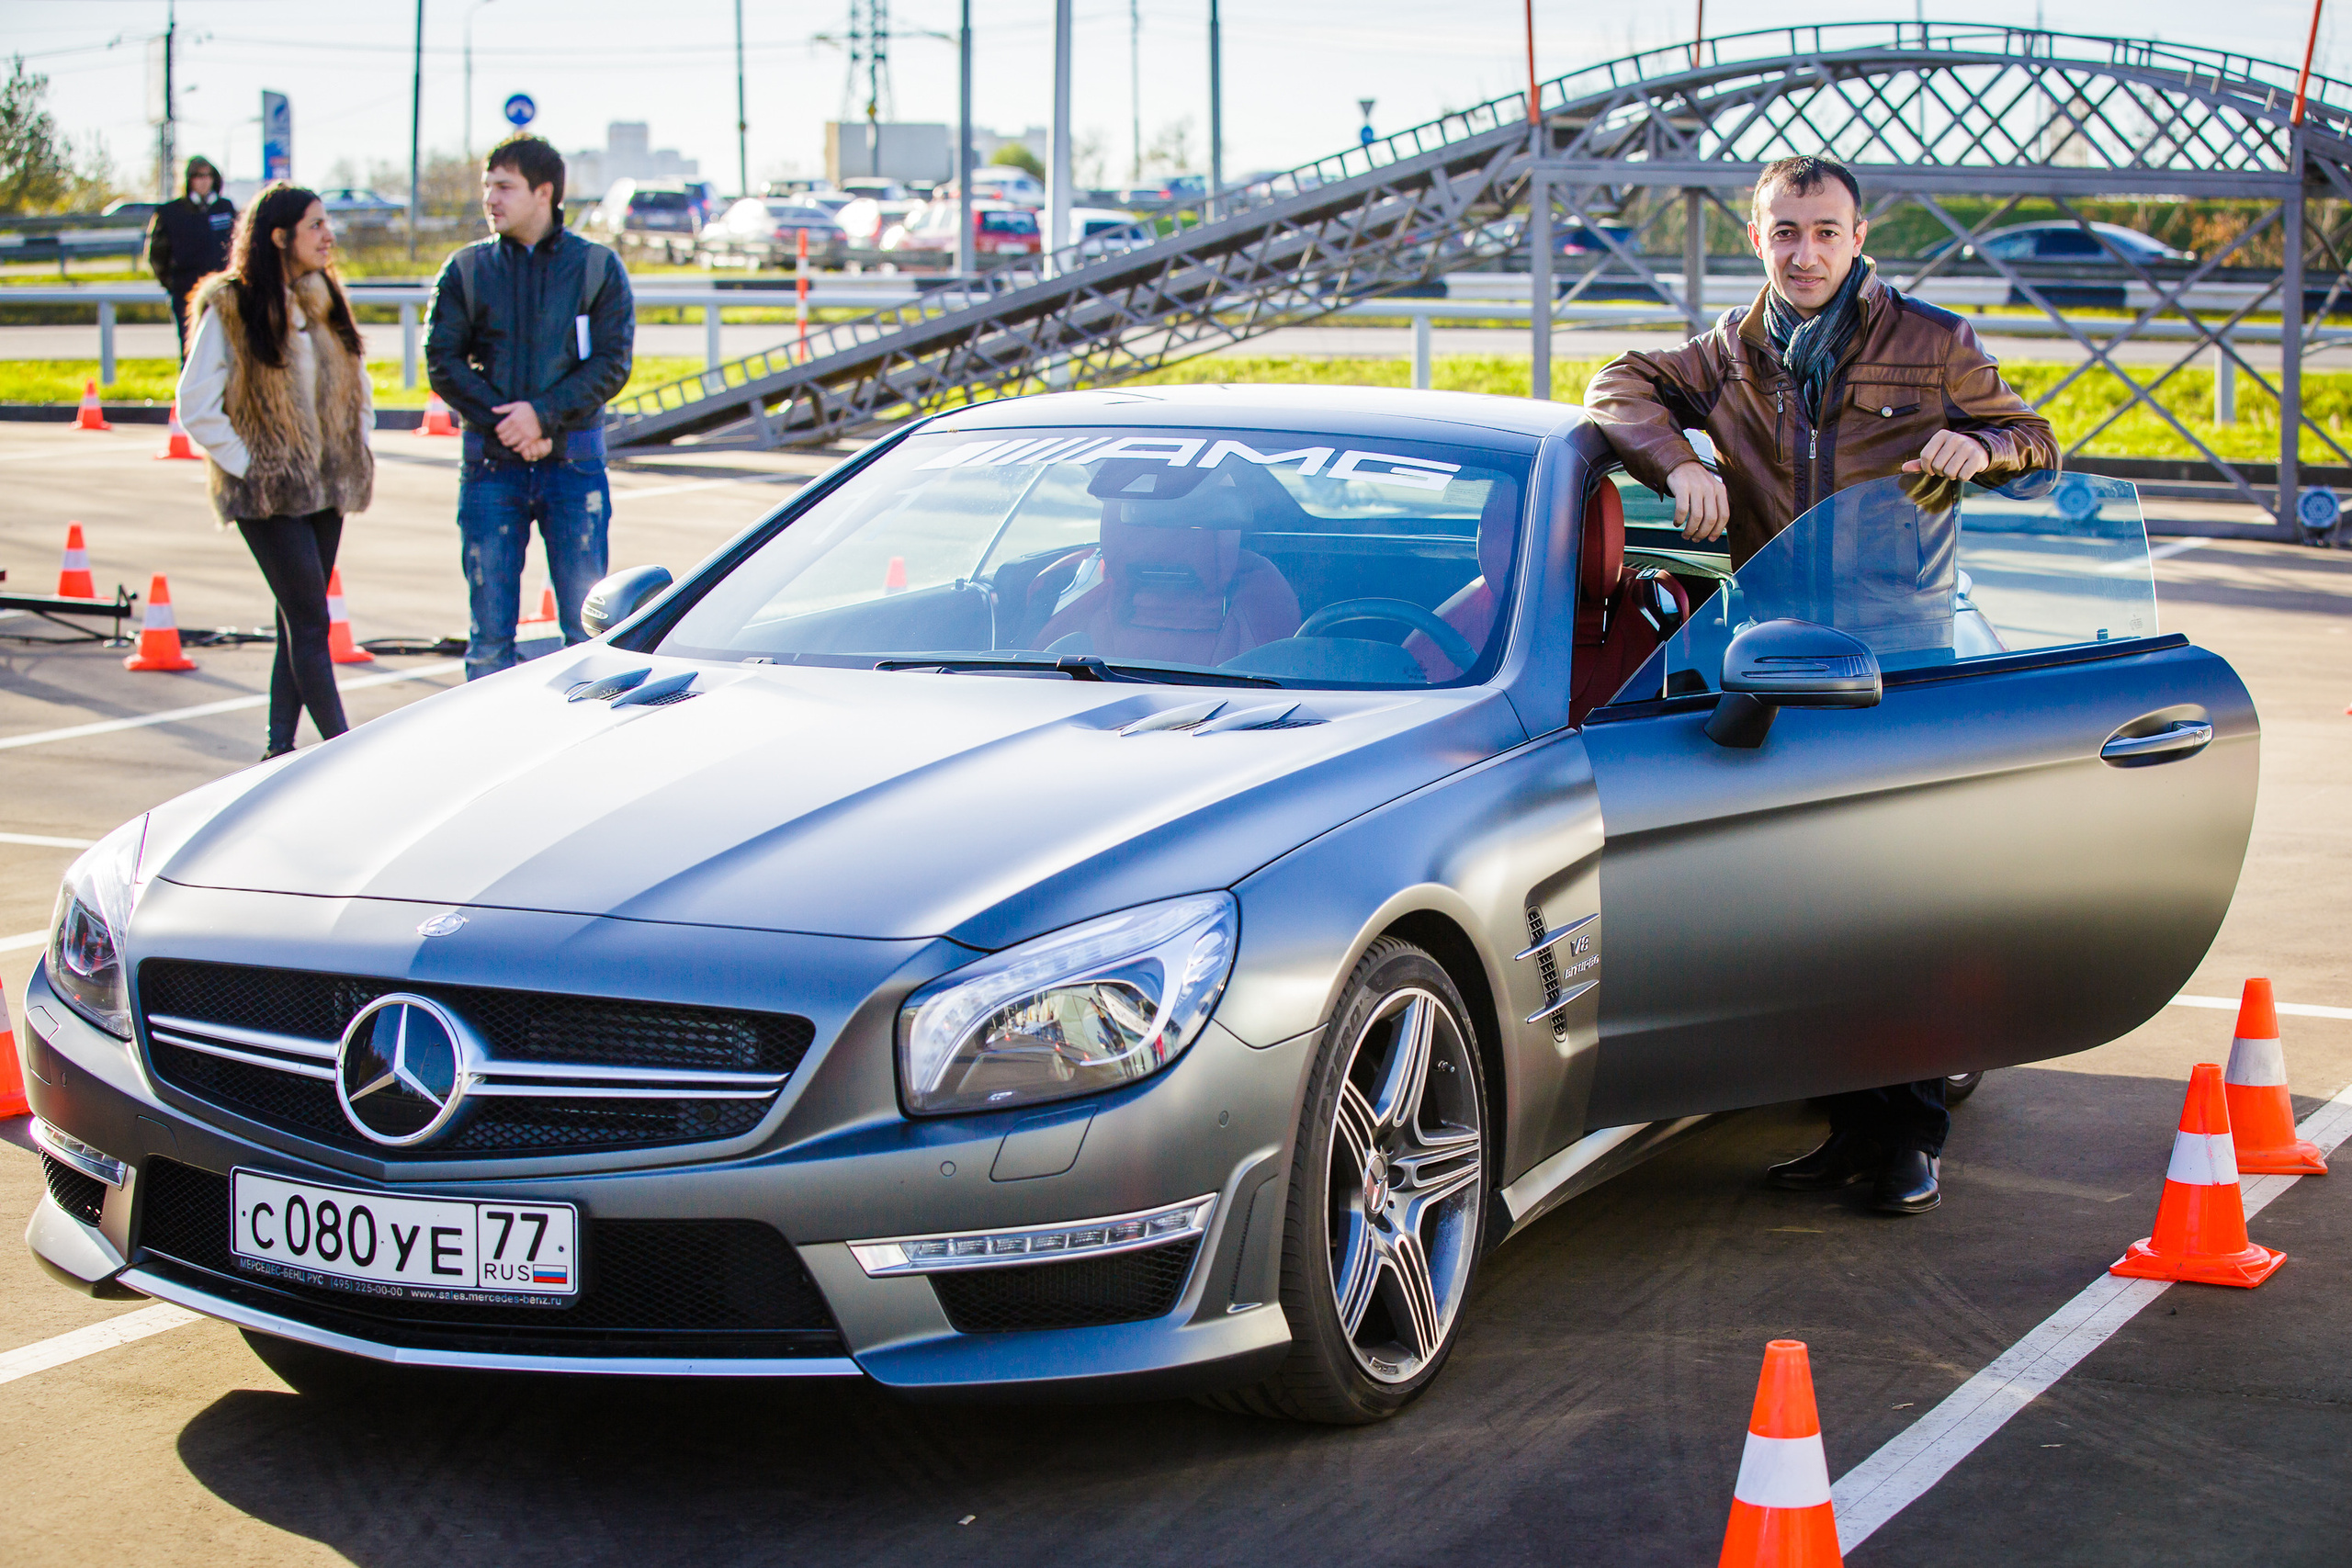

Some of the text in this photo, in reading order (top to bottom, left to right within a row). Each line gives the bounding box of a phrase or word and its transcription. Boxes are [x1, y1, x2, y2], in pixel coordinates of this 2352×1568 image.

[1066, 436, 1462, 491] AMG
[1570, 933, 1589, 957] V8
[486, 1211, 548, 1261] 77
[240, 1258, 562, 1305] МЕРСЕДЕС-БЕНЦ РУС (495) 225-00-00 www.sales.mercedes-benz.ru
[484, 1262, 530, 1281] RUS
